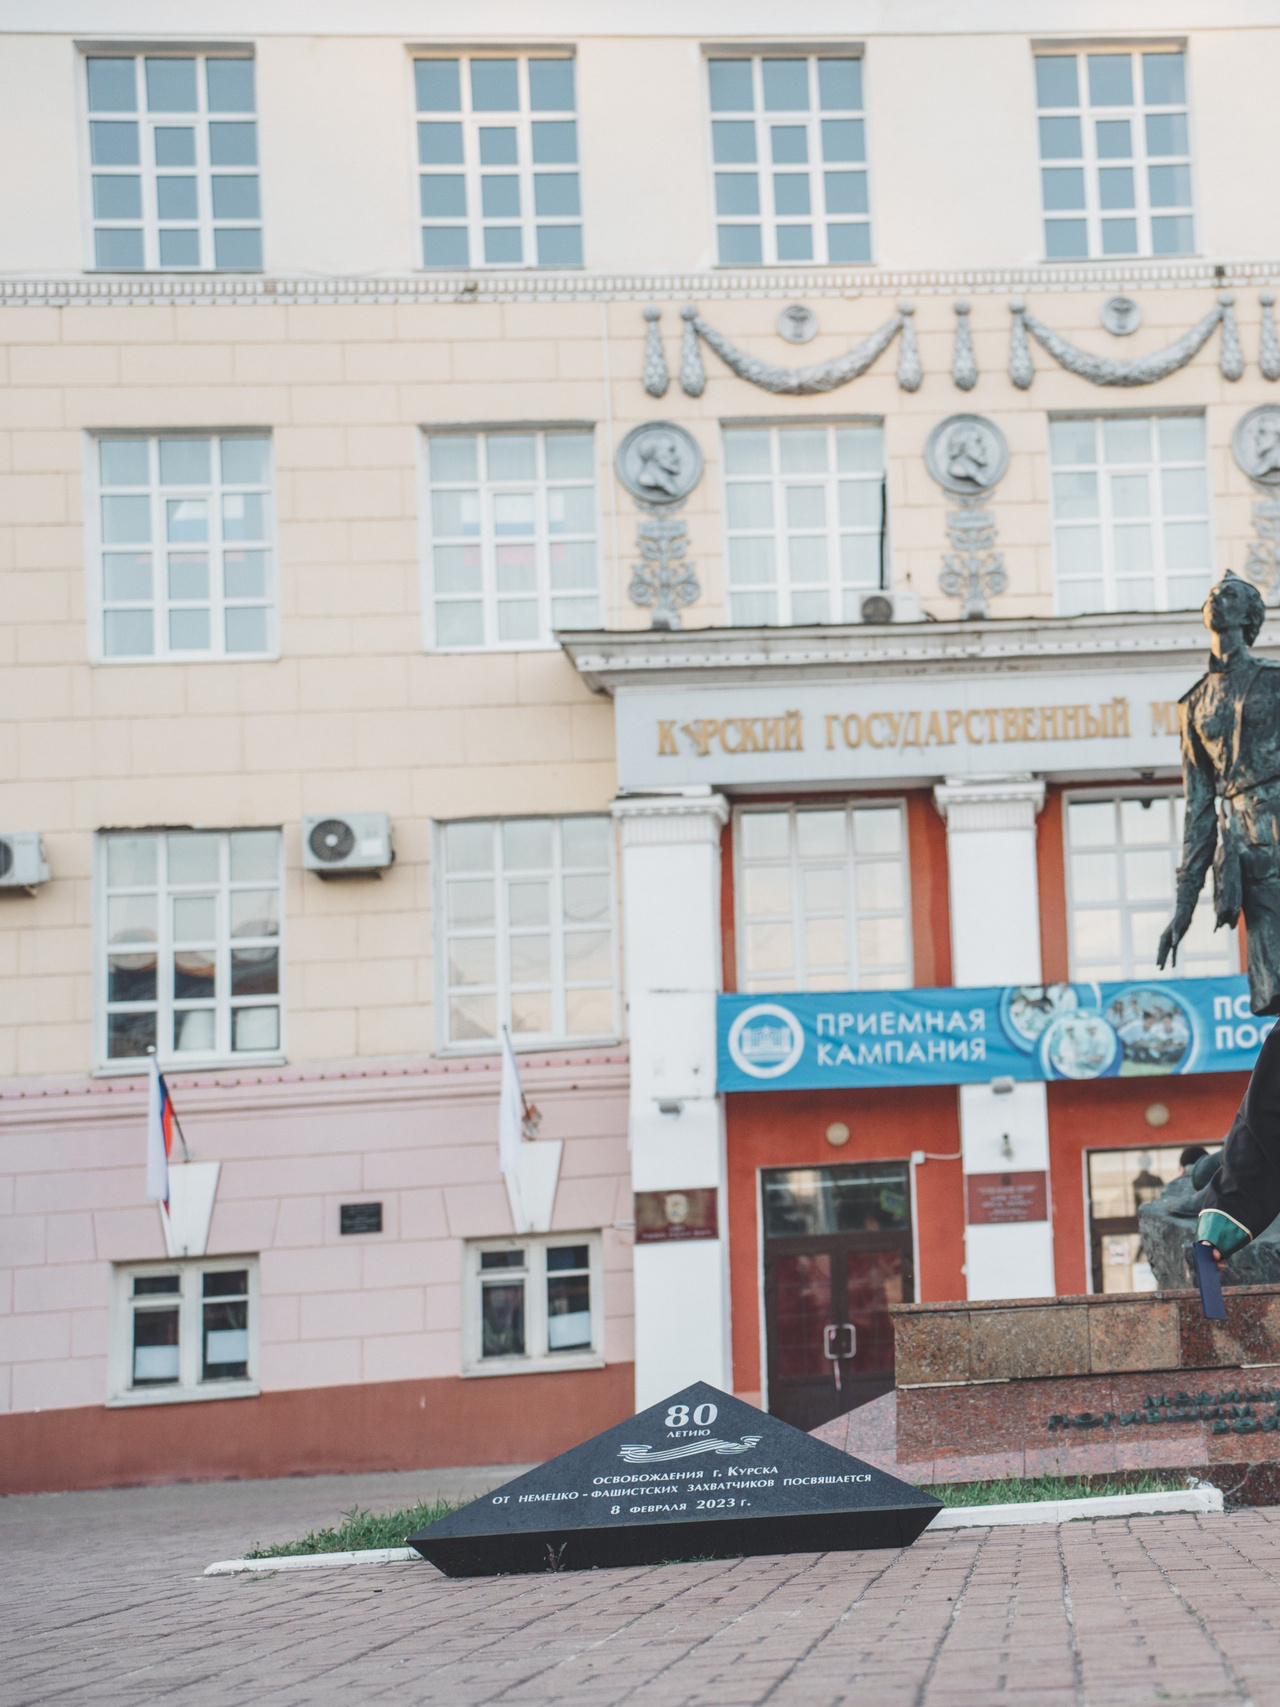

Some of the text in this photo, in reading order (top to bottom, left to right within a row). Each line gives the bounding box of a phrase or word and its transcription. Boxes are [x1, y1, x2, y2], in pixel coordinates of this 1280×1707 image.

[656, 708, 804, 756] КУРСКИЙ
[824, 696, 1131, 754] ГОСУДАРСТВЕННЫЙ
[816, 1008, 986, 1037] ПРИЕМНАЯ
[817, 1037, 987, 1067] КАМПАНИЯ
[664, 1403, 718, 1428] 80
[666, 1428, 711, 1439] ЛЕТИЮ
[492, 1495, 510, 1505] ОТ
[518, 1491, 579, 1503] НЕМЕЦКО
[590, 1485, 679, 1499] ФАШИСТСКИХ
[687, 1479, 775, 1492] ЗАХВАТЧИКОВ
[783, 1474, 872, 1486] ПОСВЯЩАЕТСЯ
[593, 1470, 704, 1485] ОСВОБОЖДЕНИЯ
[610, 1505, 621, 1515] 8
[629, 1503, 687, 1514] ФЕВРАЛЯ
[696, 1498, 736, 1510] 2023
